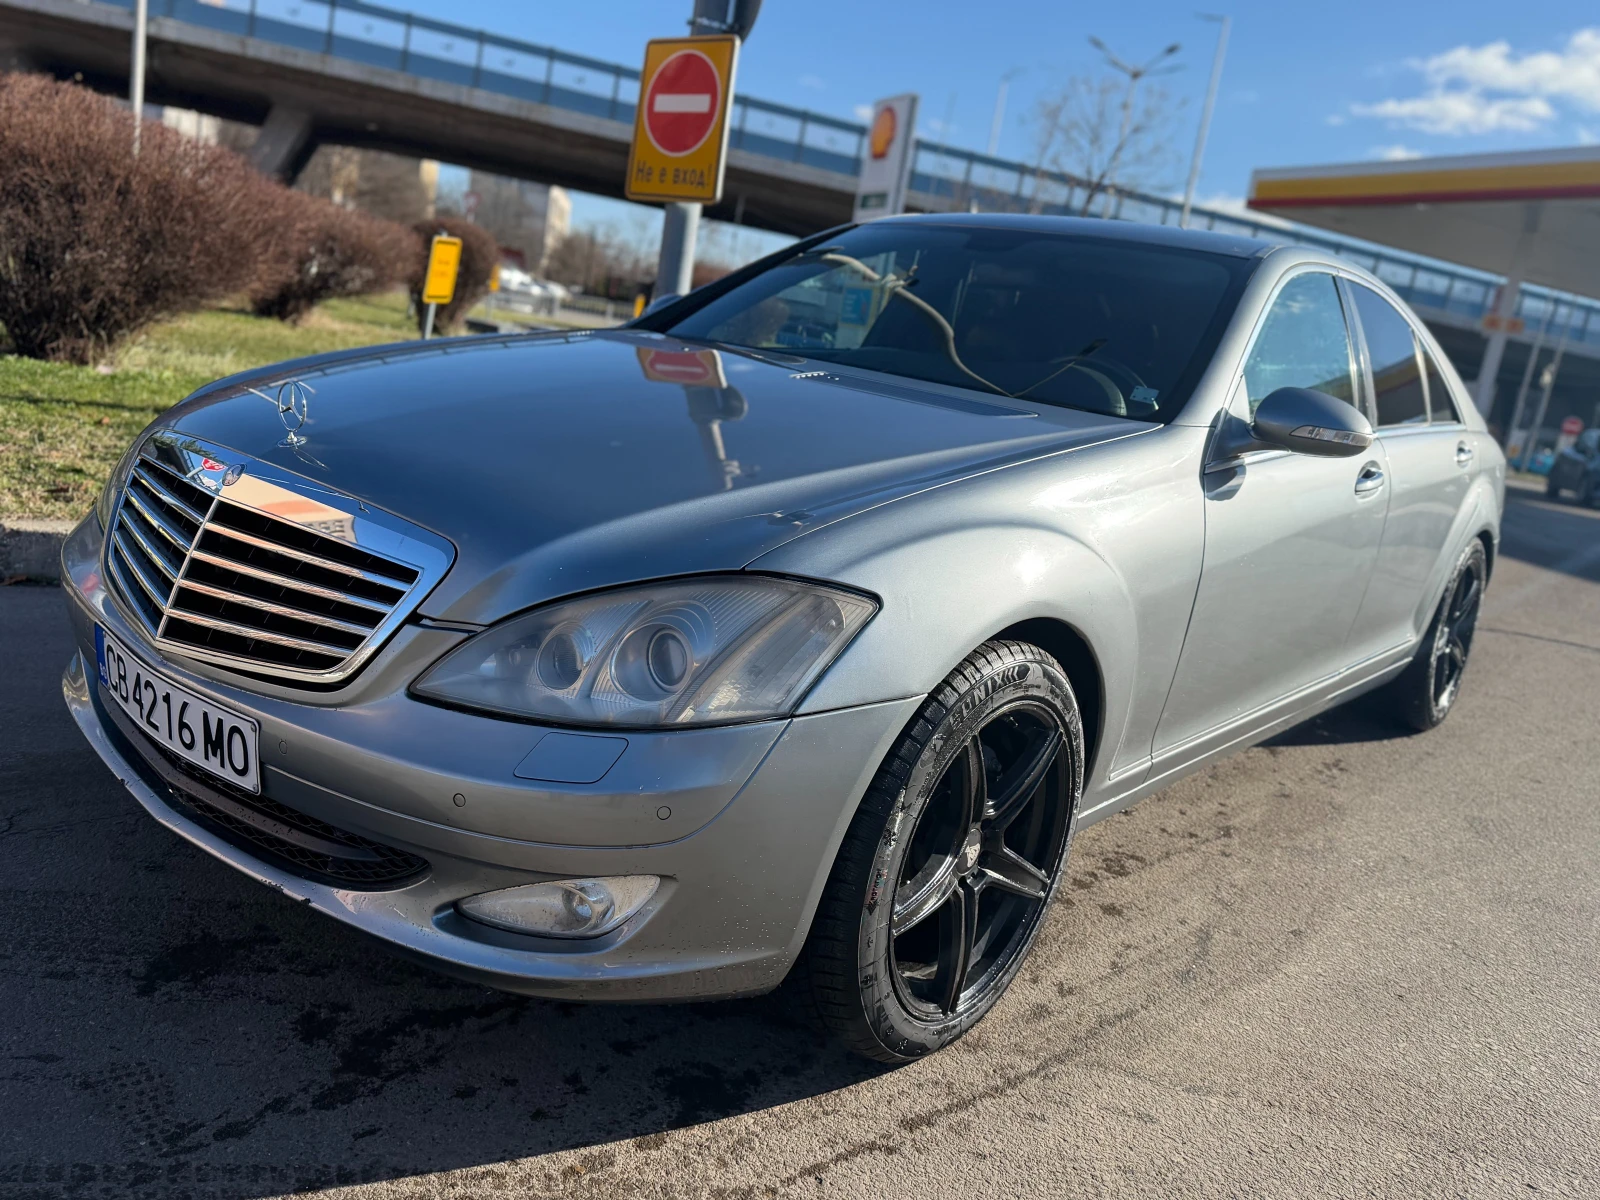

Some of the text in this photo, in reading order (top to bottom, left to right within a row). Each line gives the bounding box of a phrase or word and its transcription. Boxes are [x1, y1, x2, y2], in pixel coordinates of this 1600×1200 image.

[635, 160, 713, 189] Не е вход!
